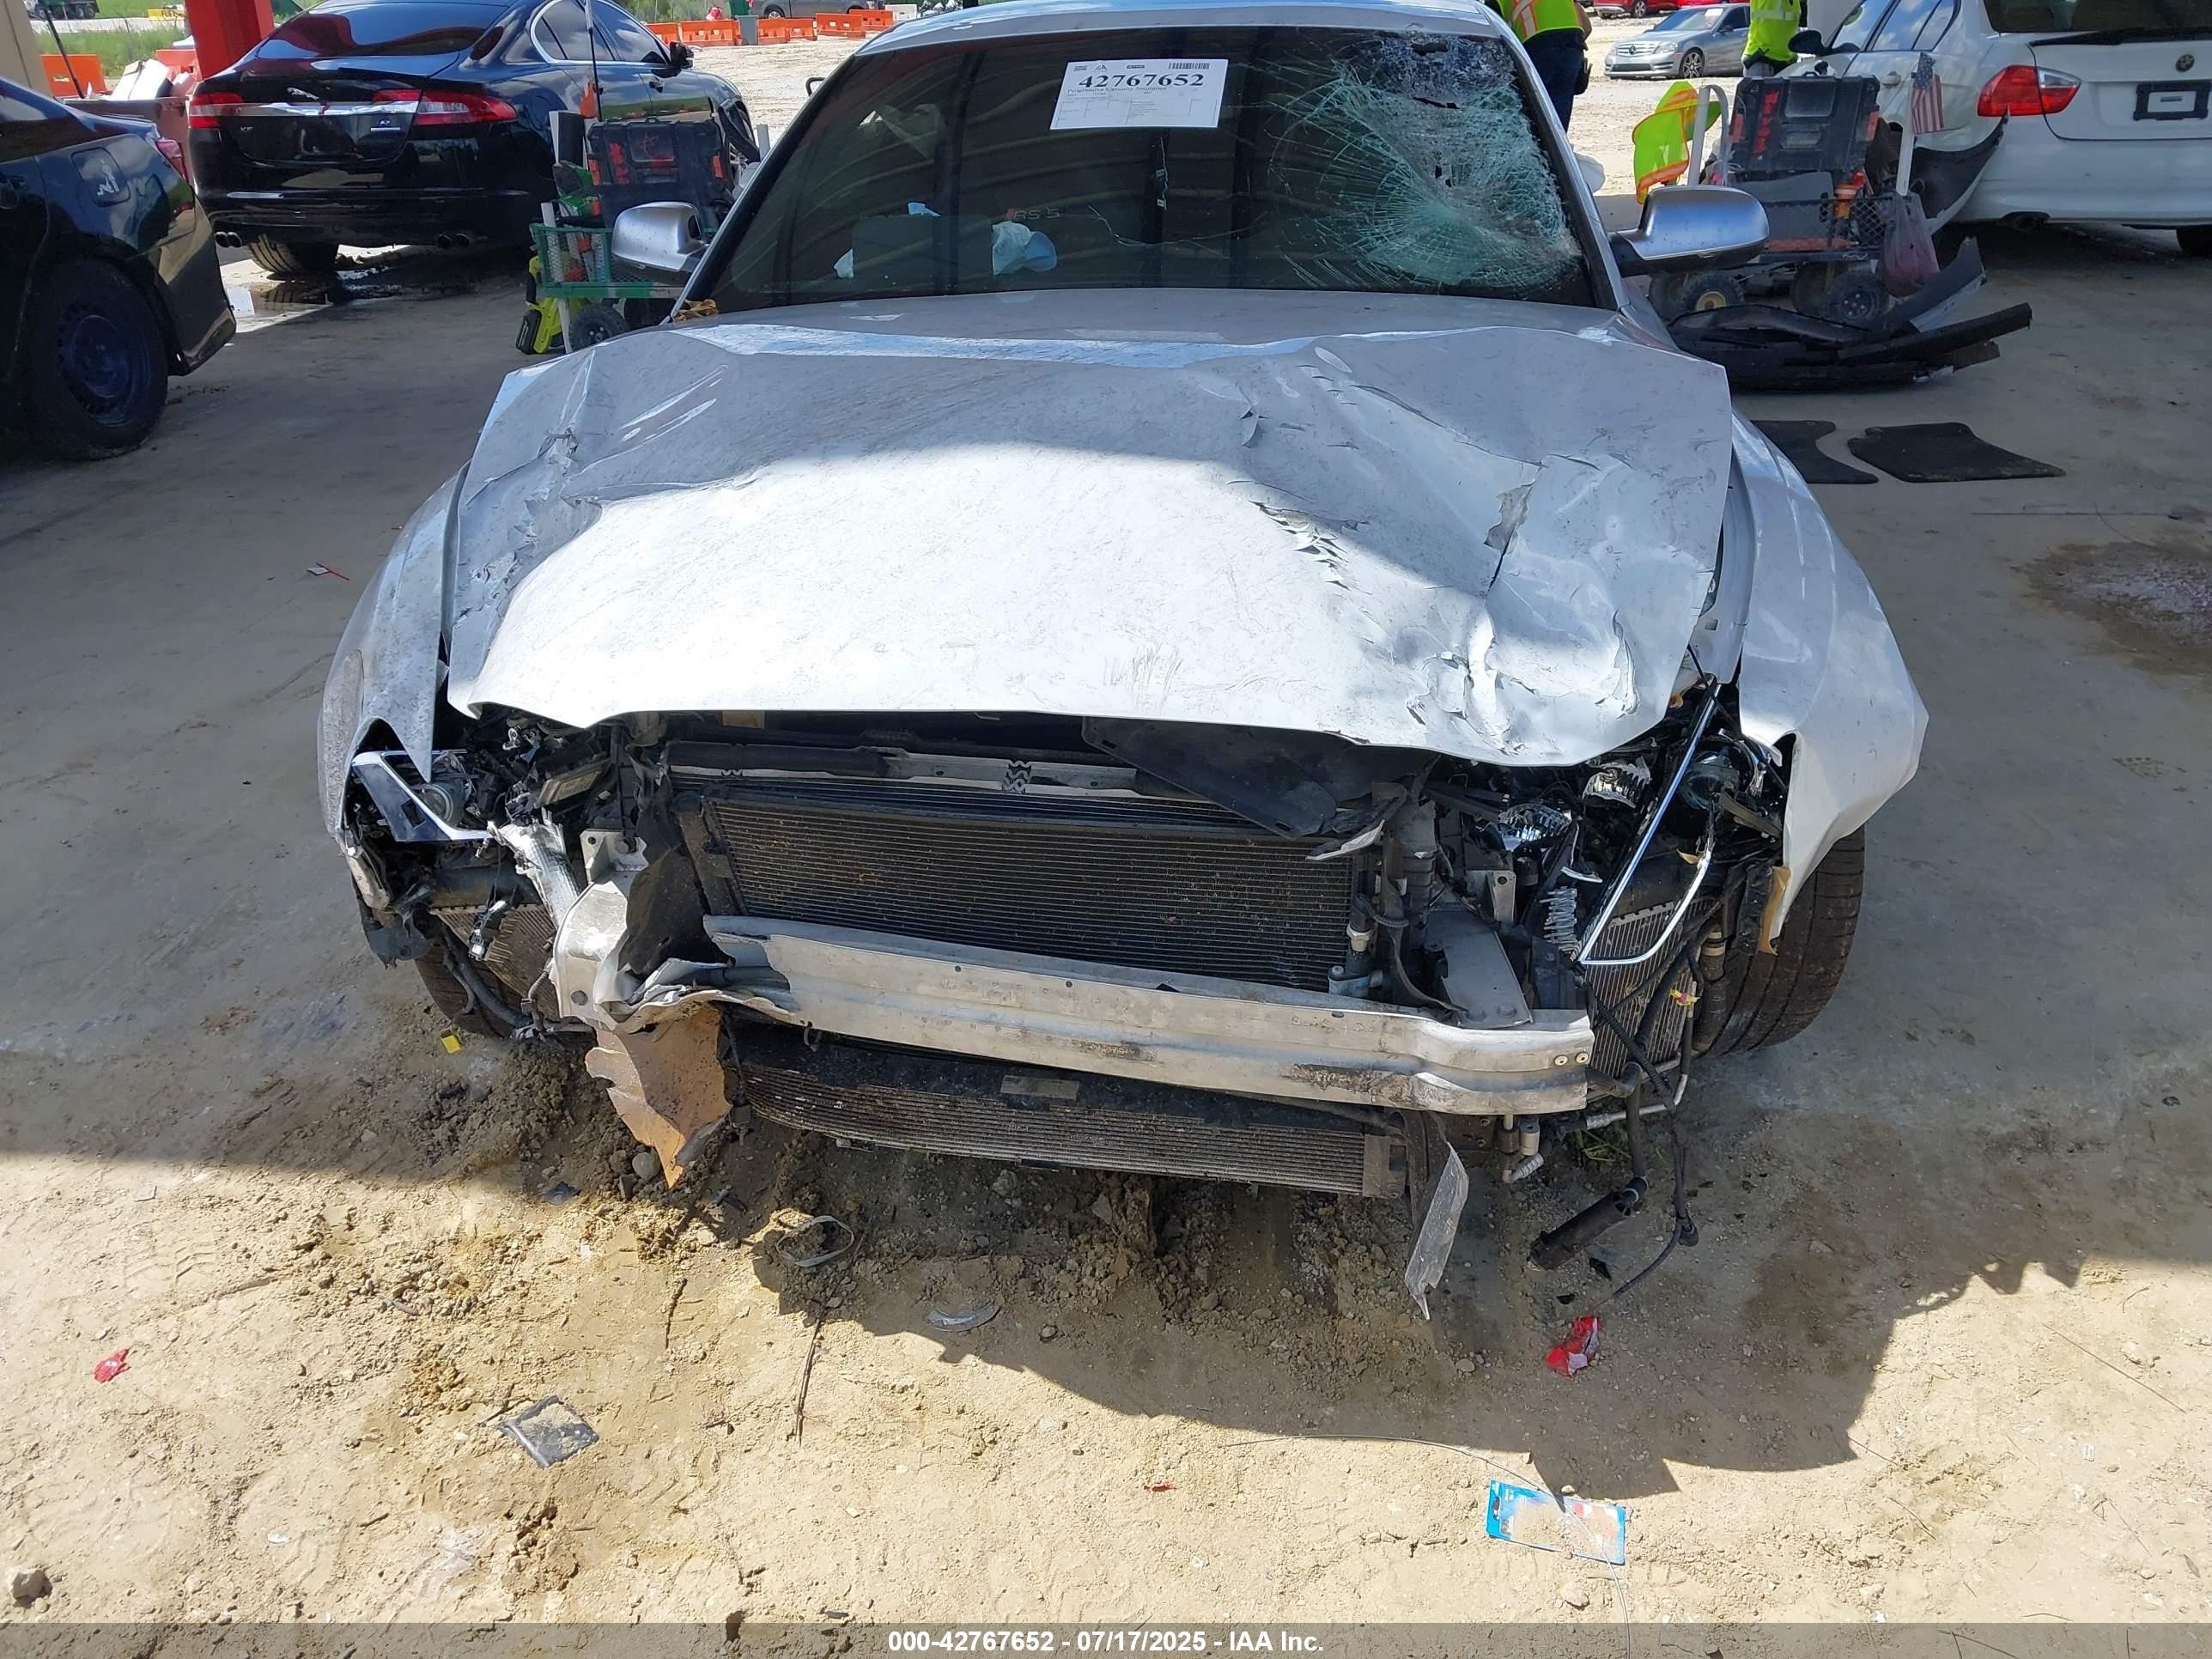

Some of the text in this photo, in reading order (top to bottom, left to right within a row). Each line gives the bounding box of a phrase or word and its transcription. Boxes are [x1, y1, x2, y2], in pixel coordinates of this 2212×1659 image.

[1078, 74, 1204, 88] 42767652
[1014, 206, 1060, 220] RS 5
